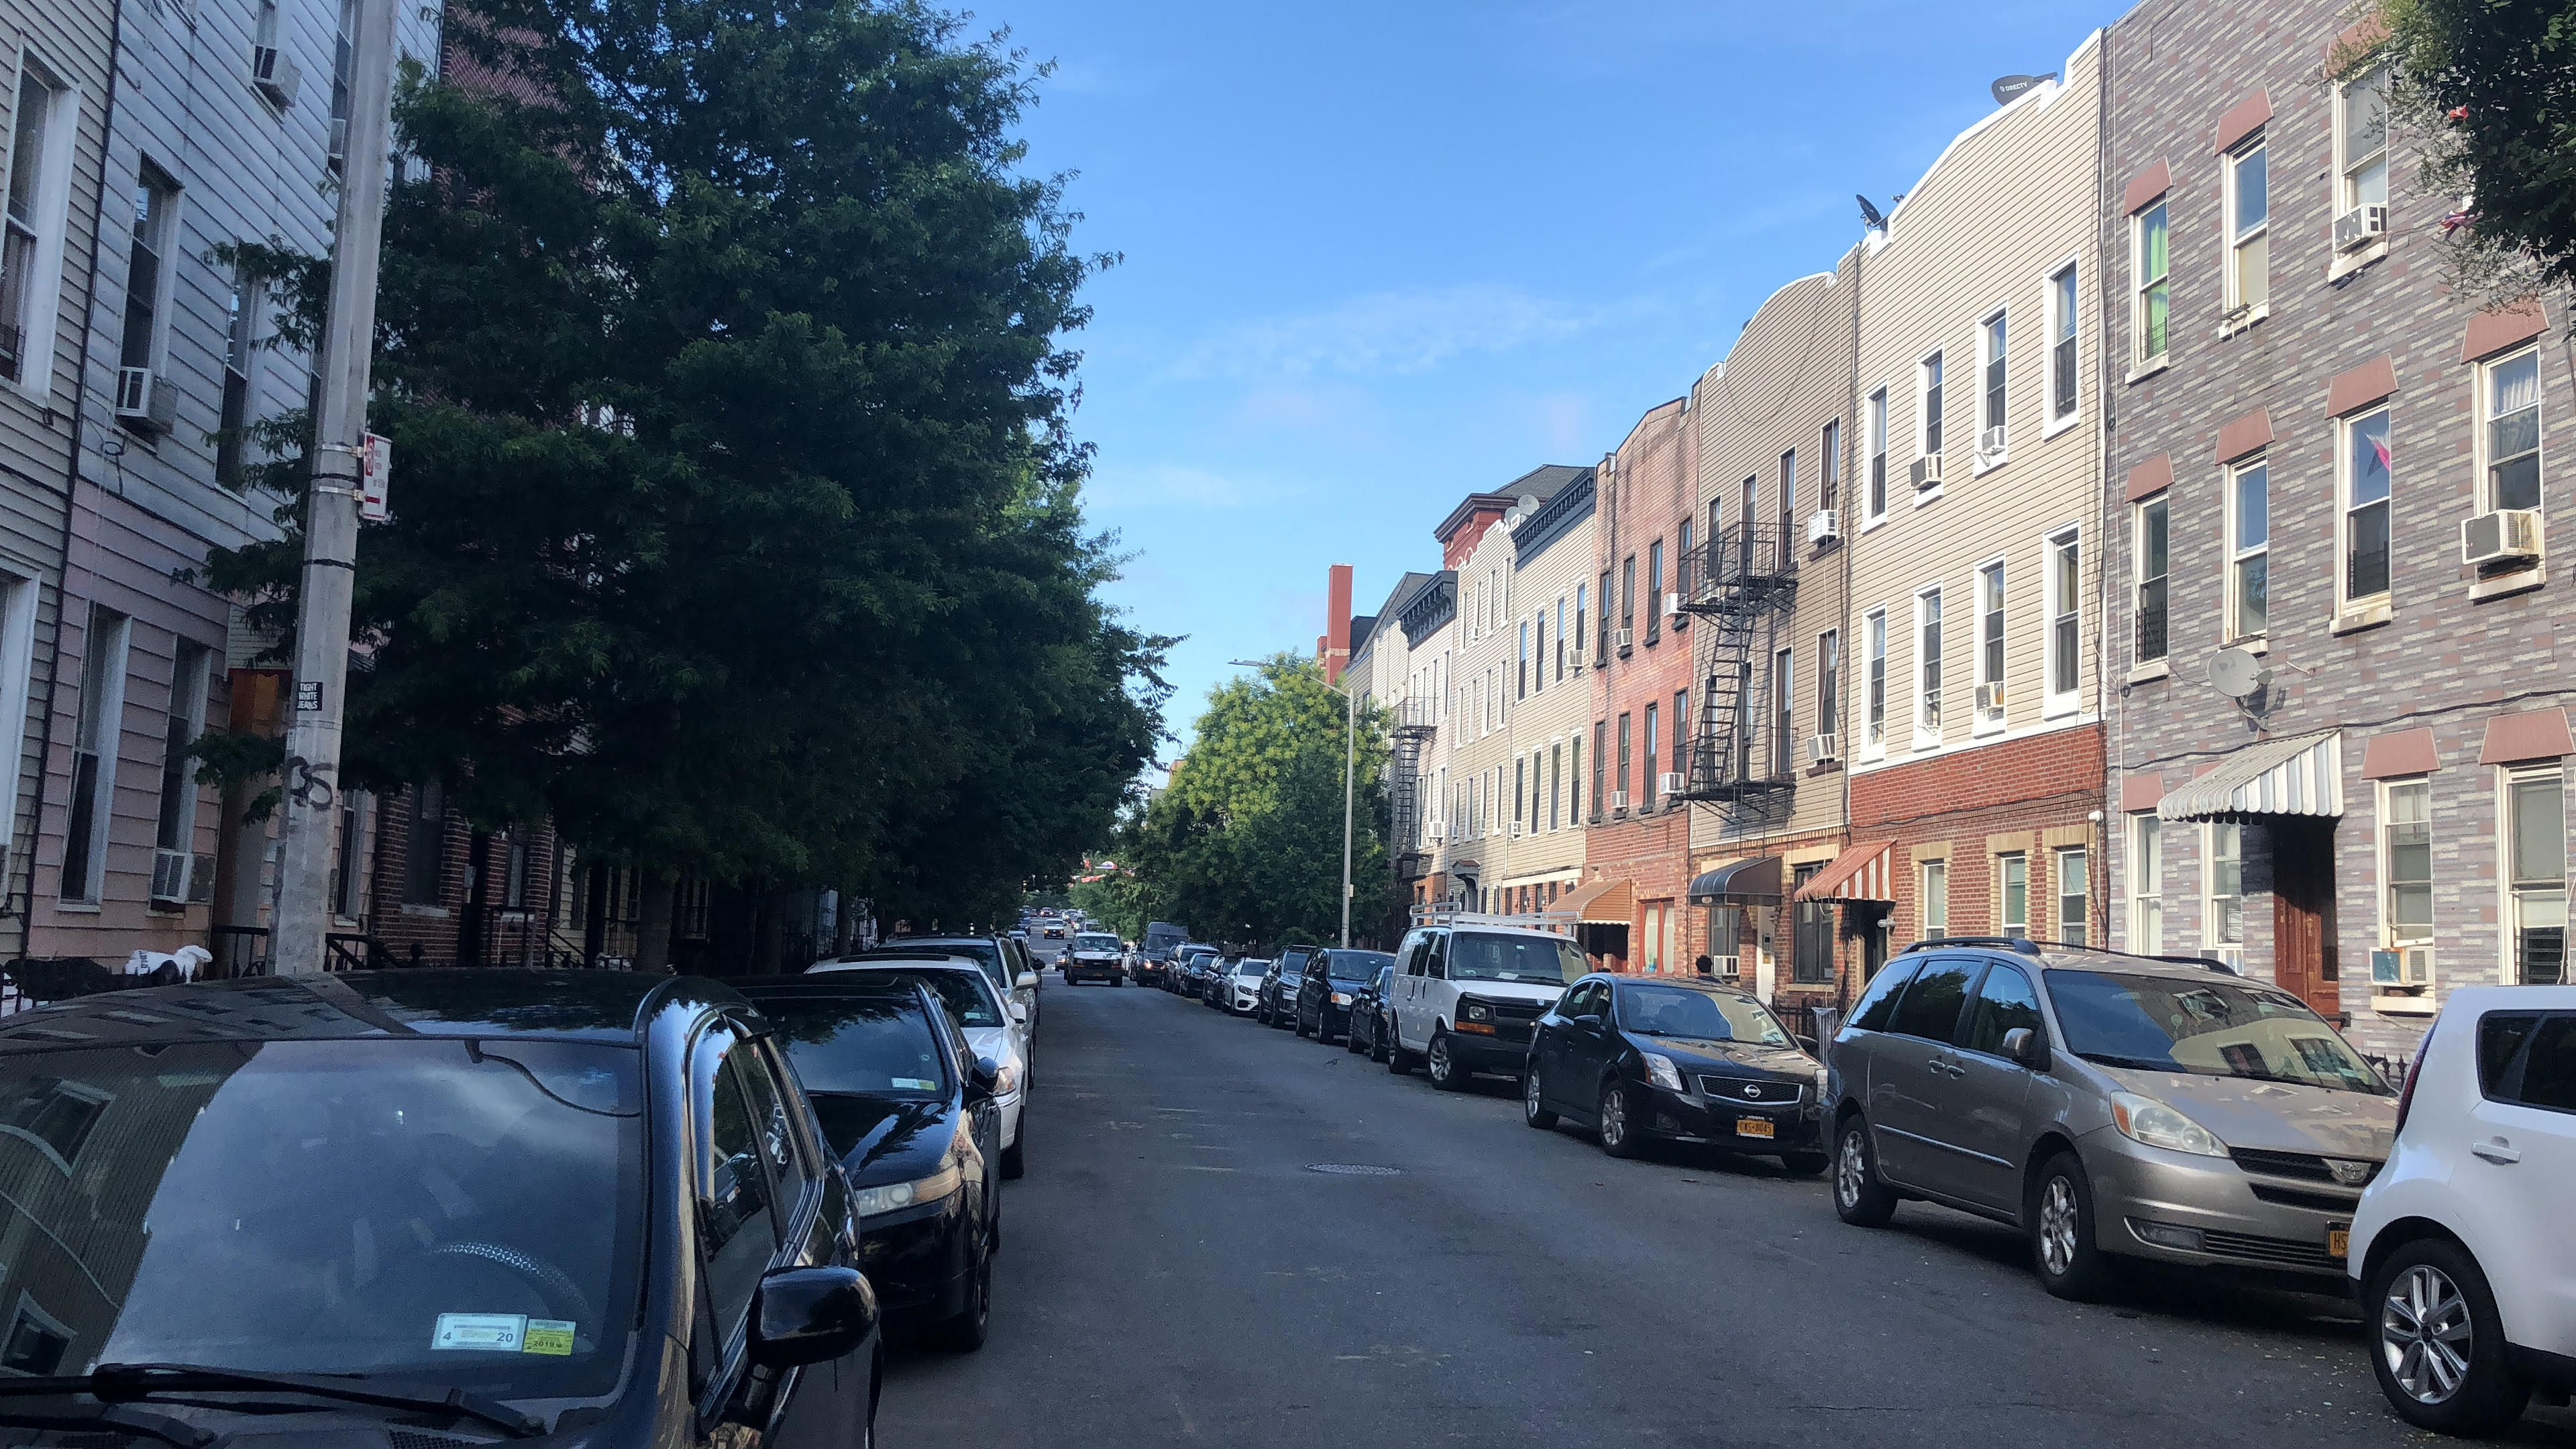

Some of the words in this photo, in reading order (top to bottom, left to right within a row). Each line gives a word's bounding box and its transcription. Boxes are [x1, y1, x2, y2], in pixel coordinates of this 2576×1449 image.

[2005, 82, 2027, 91] DIRECTV
[300, 683, 317, 691] TIGHT
[299, 692, 317, 700] WHITE
[297, 700, 318, 709] JEANS
[443, 1332, 451, 1341] 4
[496, 1332, 513, 1342] 20
[533, 1340, 555, 1348] 2019
